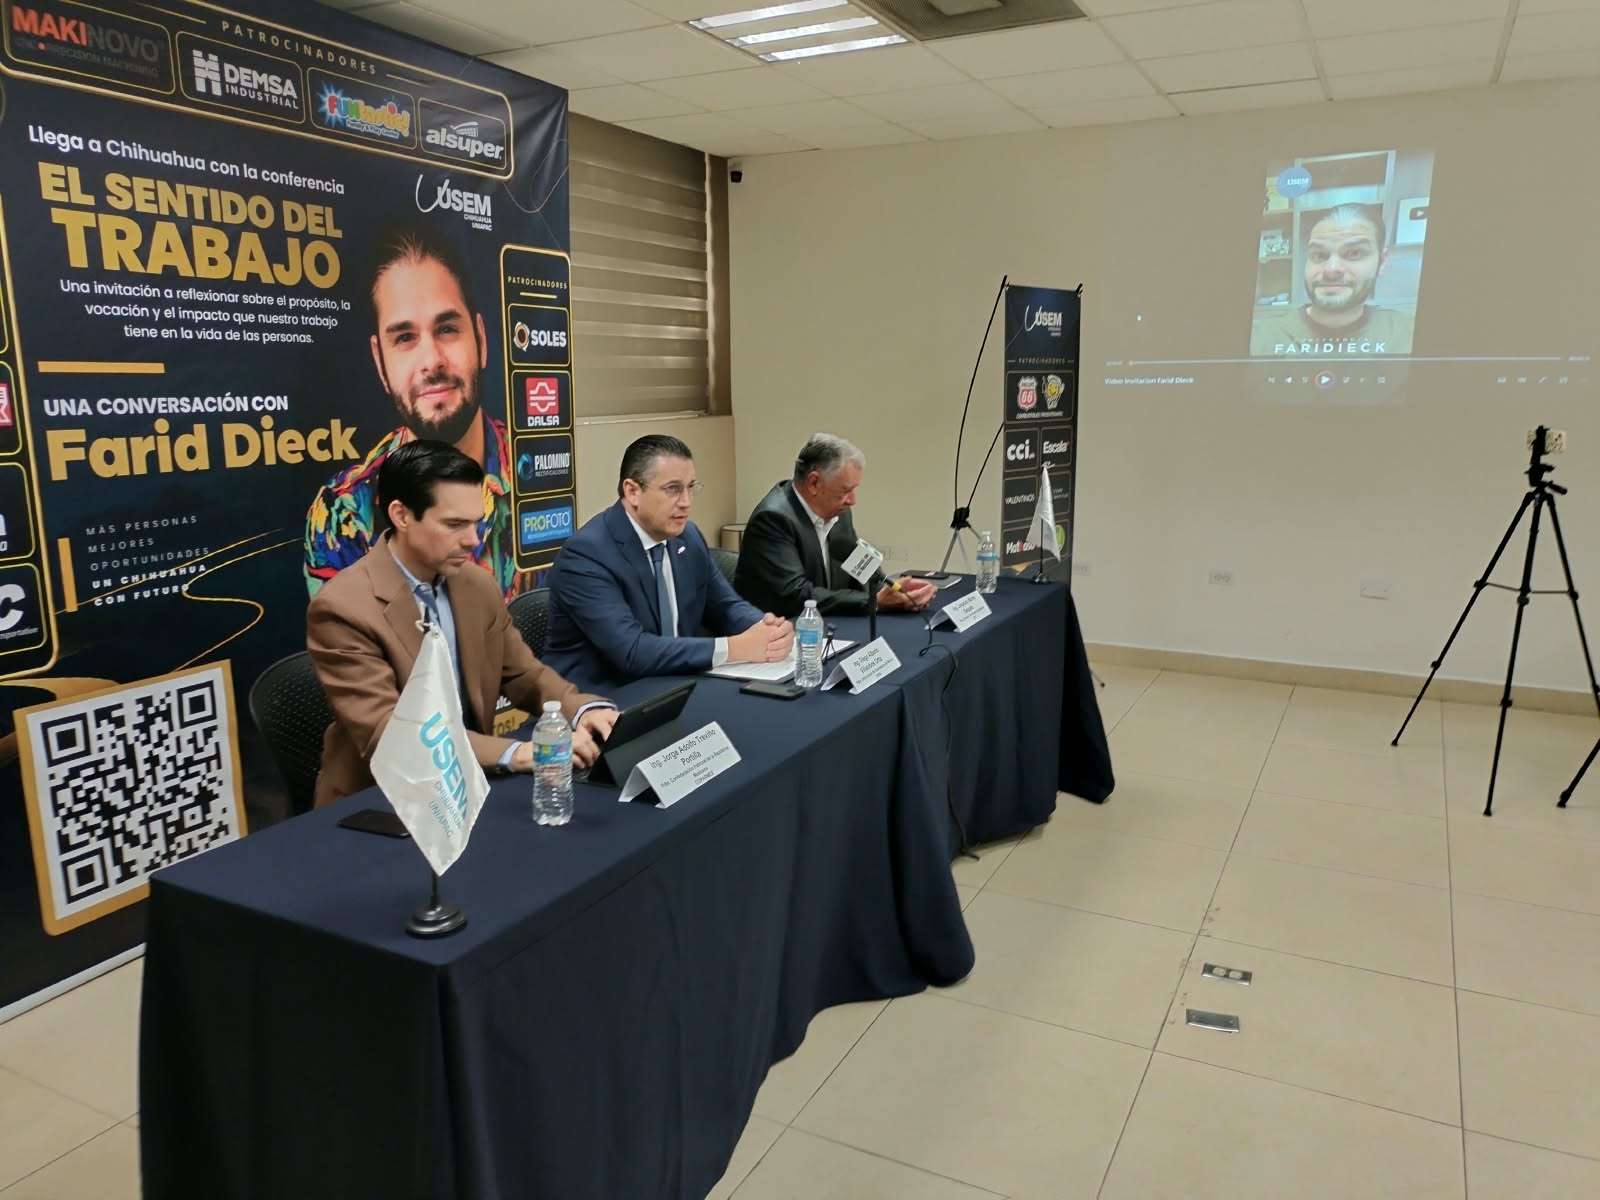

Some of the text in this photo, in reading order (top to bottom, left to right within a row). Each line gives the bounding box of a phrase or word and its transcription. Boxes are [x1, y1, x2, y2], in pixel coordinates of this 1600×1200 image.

[12, 5, 160, 62] MAKINOVO
[221, 20, 377, 75] PATROCINADORES
[223, 62, 298, 99] DEMSA
[225, 83, 299, 110] INDUSTRIAL
[425, 126, 504, 160] alsuper
[28, 124, 345, 196] Llega a Chihuahua con la conferencia
[38, 161, 343, 240] EL SENTIDO DEL
[437, 180, 492, 217] USEM
[50, 207, 341, 289] TRABAJO
[507, 275, 568, 290] PATROCINADORES
[60, 279, 351, 312] Una invitación a reflexionar sobre el propósito, la
[85, 303, 339, 329] vocación y el impacto que nuestro trabajo
[124, 325, 314, 346] tiene en la vida de las personas.
[530, 329, 567, 348] SOLES
[44, 392, 289, 416] UNA CONVERSACIÓN CON
[527, 415, 560, 427] DALSA
[46, 414, 361, 481] Farid Dieck
[534, 452, 570, 471] PALOMINO
[125, 515, 198, 531] PERSONAS
[524, 511, 570, 534] PROFOTO
[88, 537, 155, 553] MEJORES
[90, 547, 209, 571] OPORTUNIDADES
[92, 564, 207, 589] UN CHIHUAHUA
[94, 583, 189, 607] CON FUTURO
[678, 740, 697, 754] Adolfo
